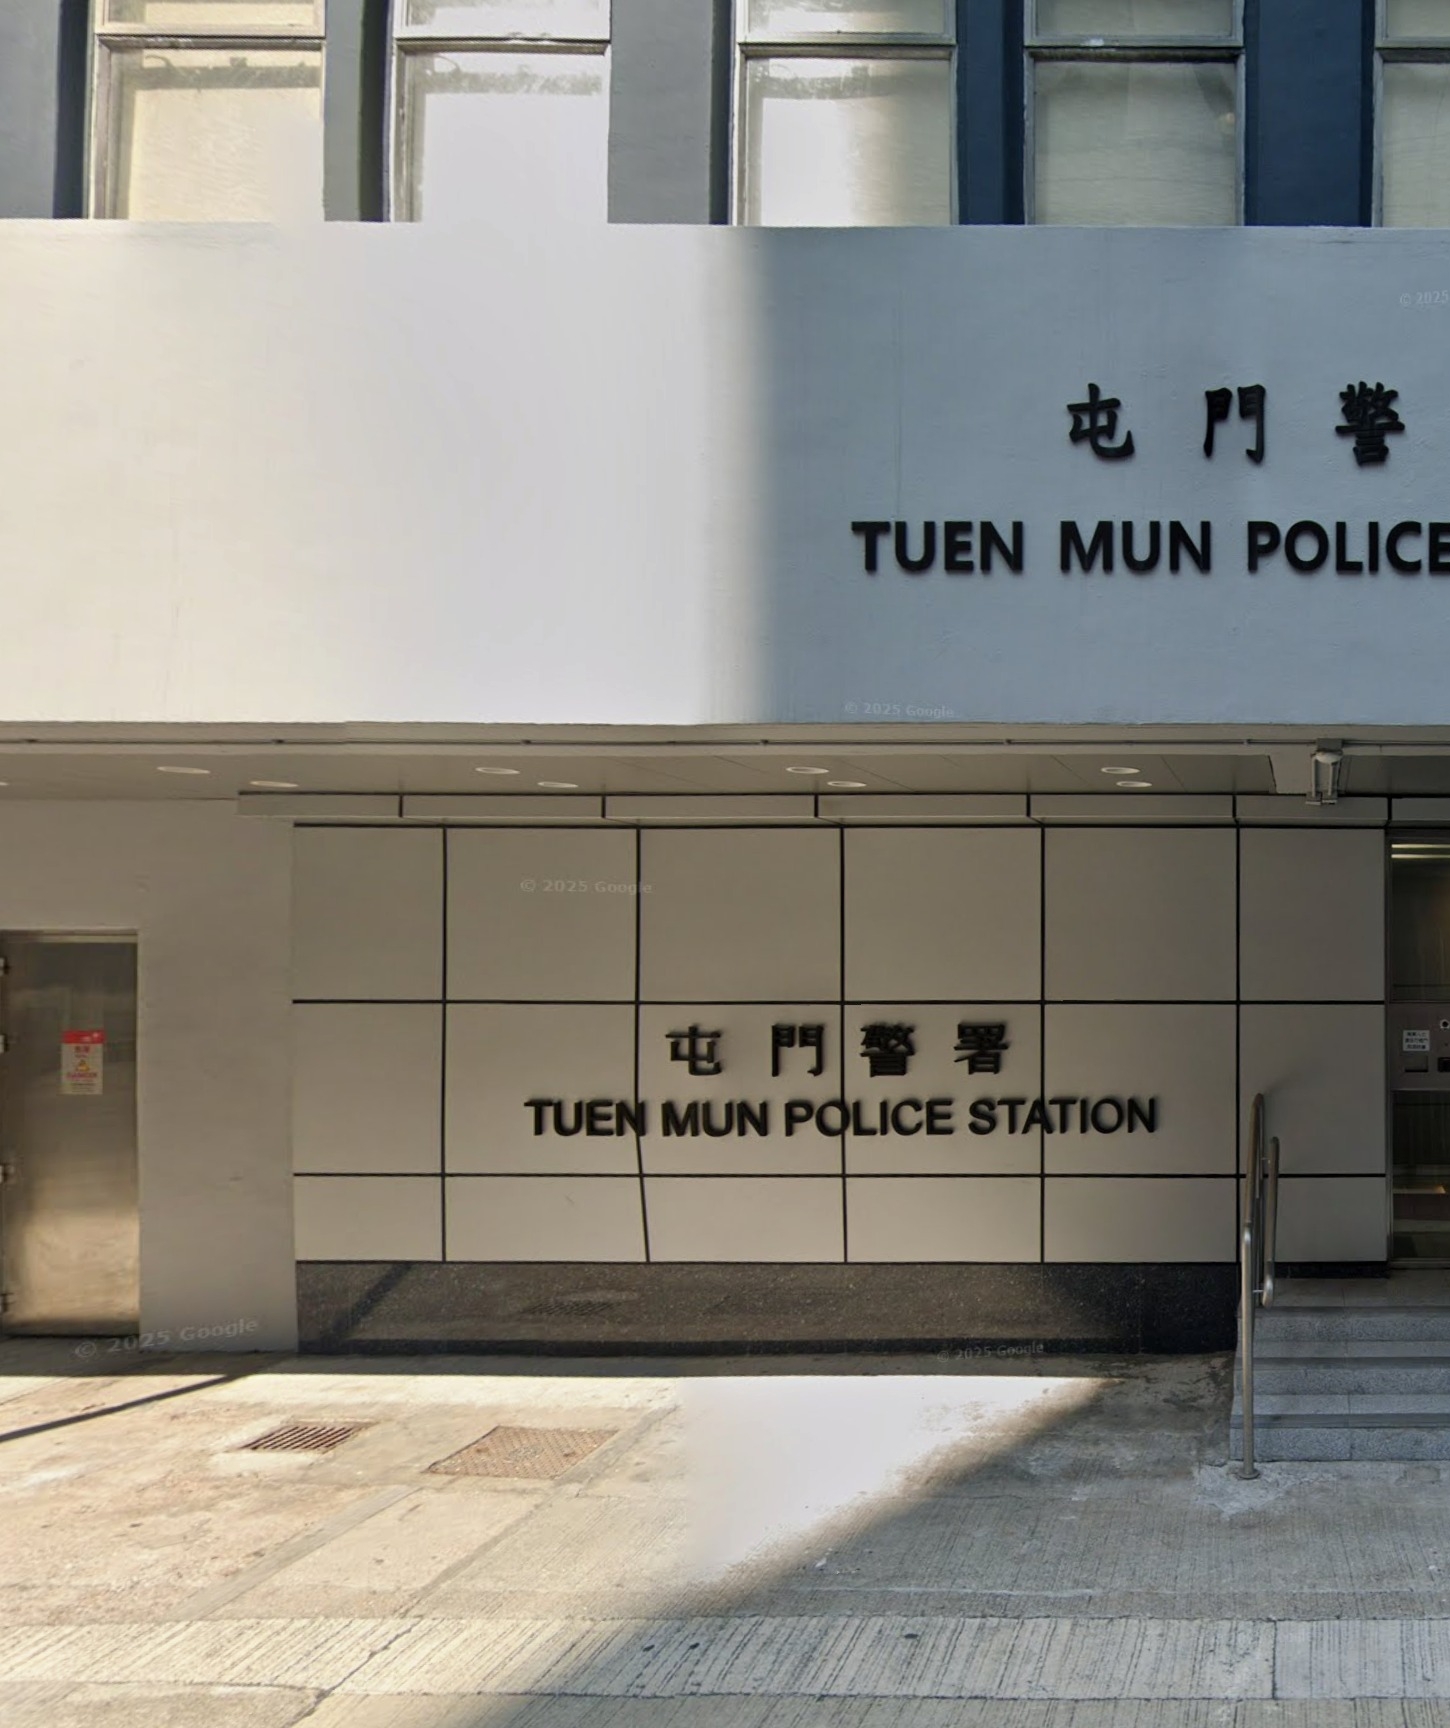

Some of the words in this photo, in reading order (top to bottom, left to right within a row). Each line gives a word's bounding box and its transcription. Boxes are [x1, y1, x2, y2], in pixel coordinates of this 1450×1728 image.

[851, 521, 1024, 576] TUEN
[1060, 521, 1212, 576] MUN
[666, 1023, 1010, 1078] 屯門警署
[525, 1099, 645, 1138] TUEN
[662, 1099, 768, 1138] MUN
[785, 1098, 954, 1138] POLICE
[968, 1097, 1157, 1136] STATION
